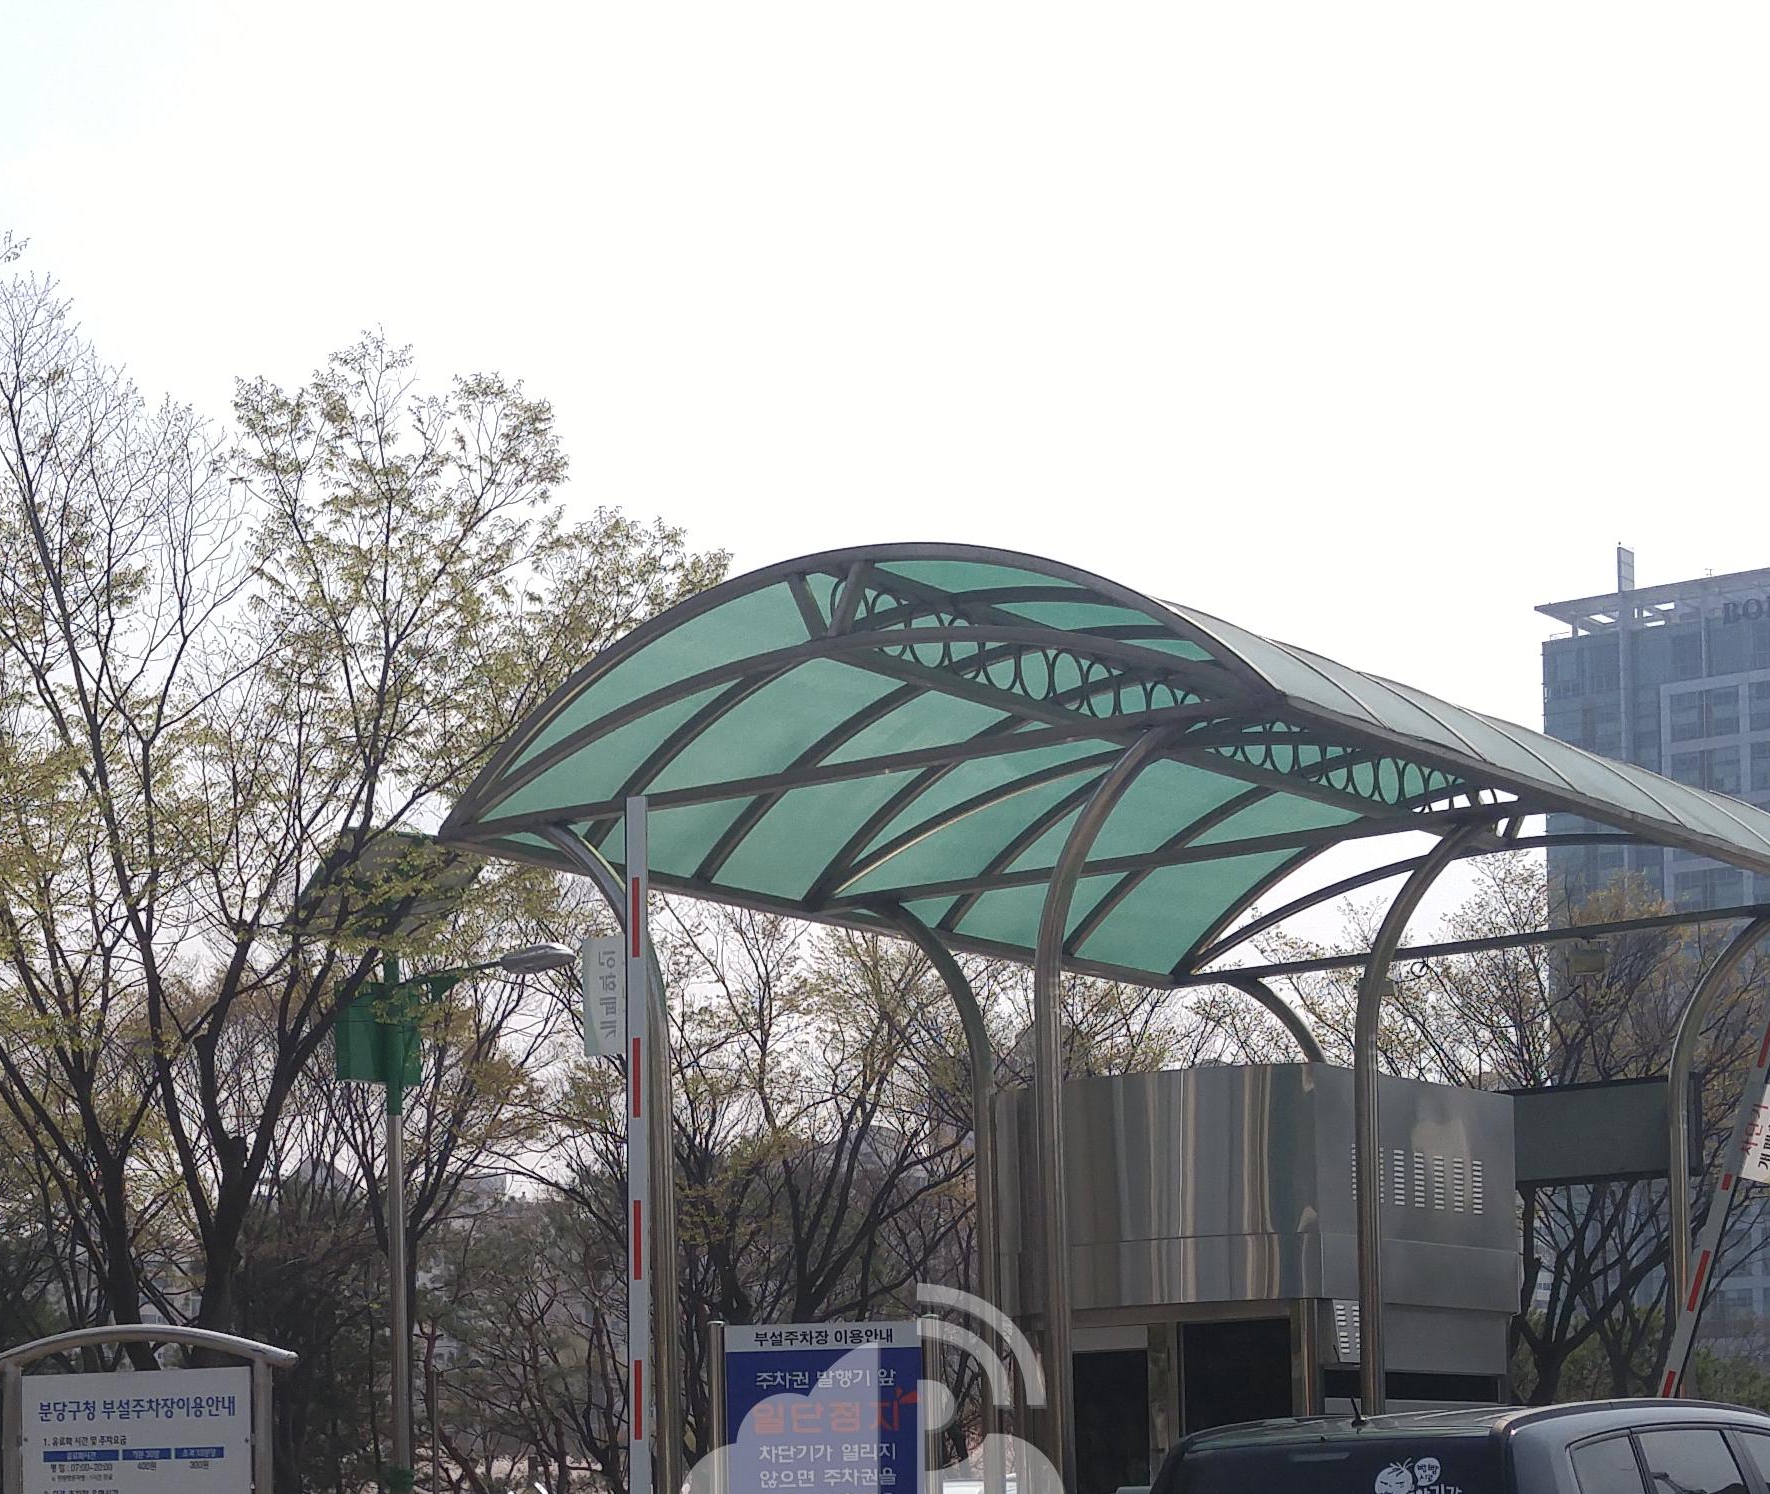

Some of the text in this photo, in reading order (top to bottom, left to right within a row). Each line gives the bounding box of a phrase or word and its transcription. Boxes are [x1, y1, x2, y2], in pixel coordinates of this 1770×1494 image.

[754, 1328, 894, 1347] 부설주차장 이용안내
[756, 1368, 896, 1390] 주차권 발행기 앞
[38, 1396, 236, 1422] 분당구청 부설주차장이용안내
[753, 1399, 900, 1435] 일단정지
[759, 1443, 896, 1463] 차단기가 열리지
[760, 1467, 897, 1488] 않으면 주차권을
